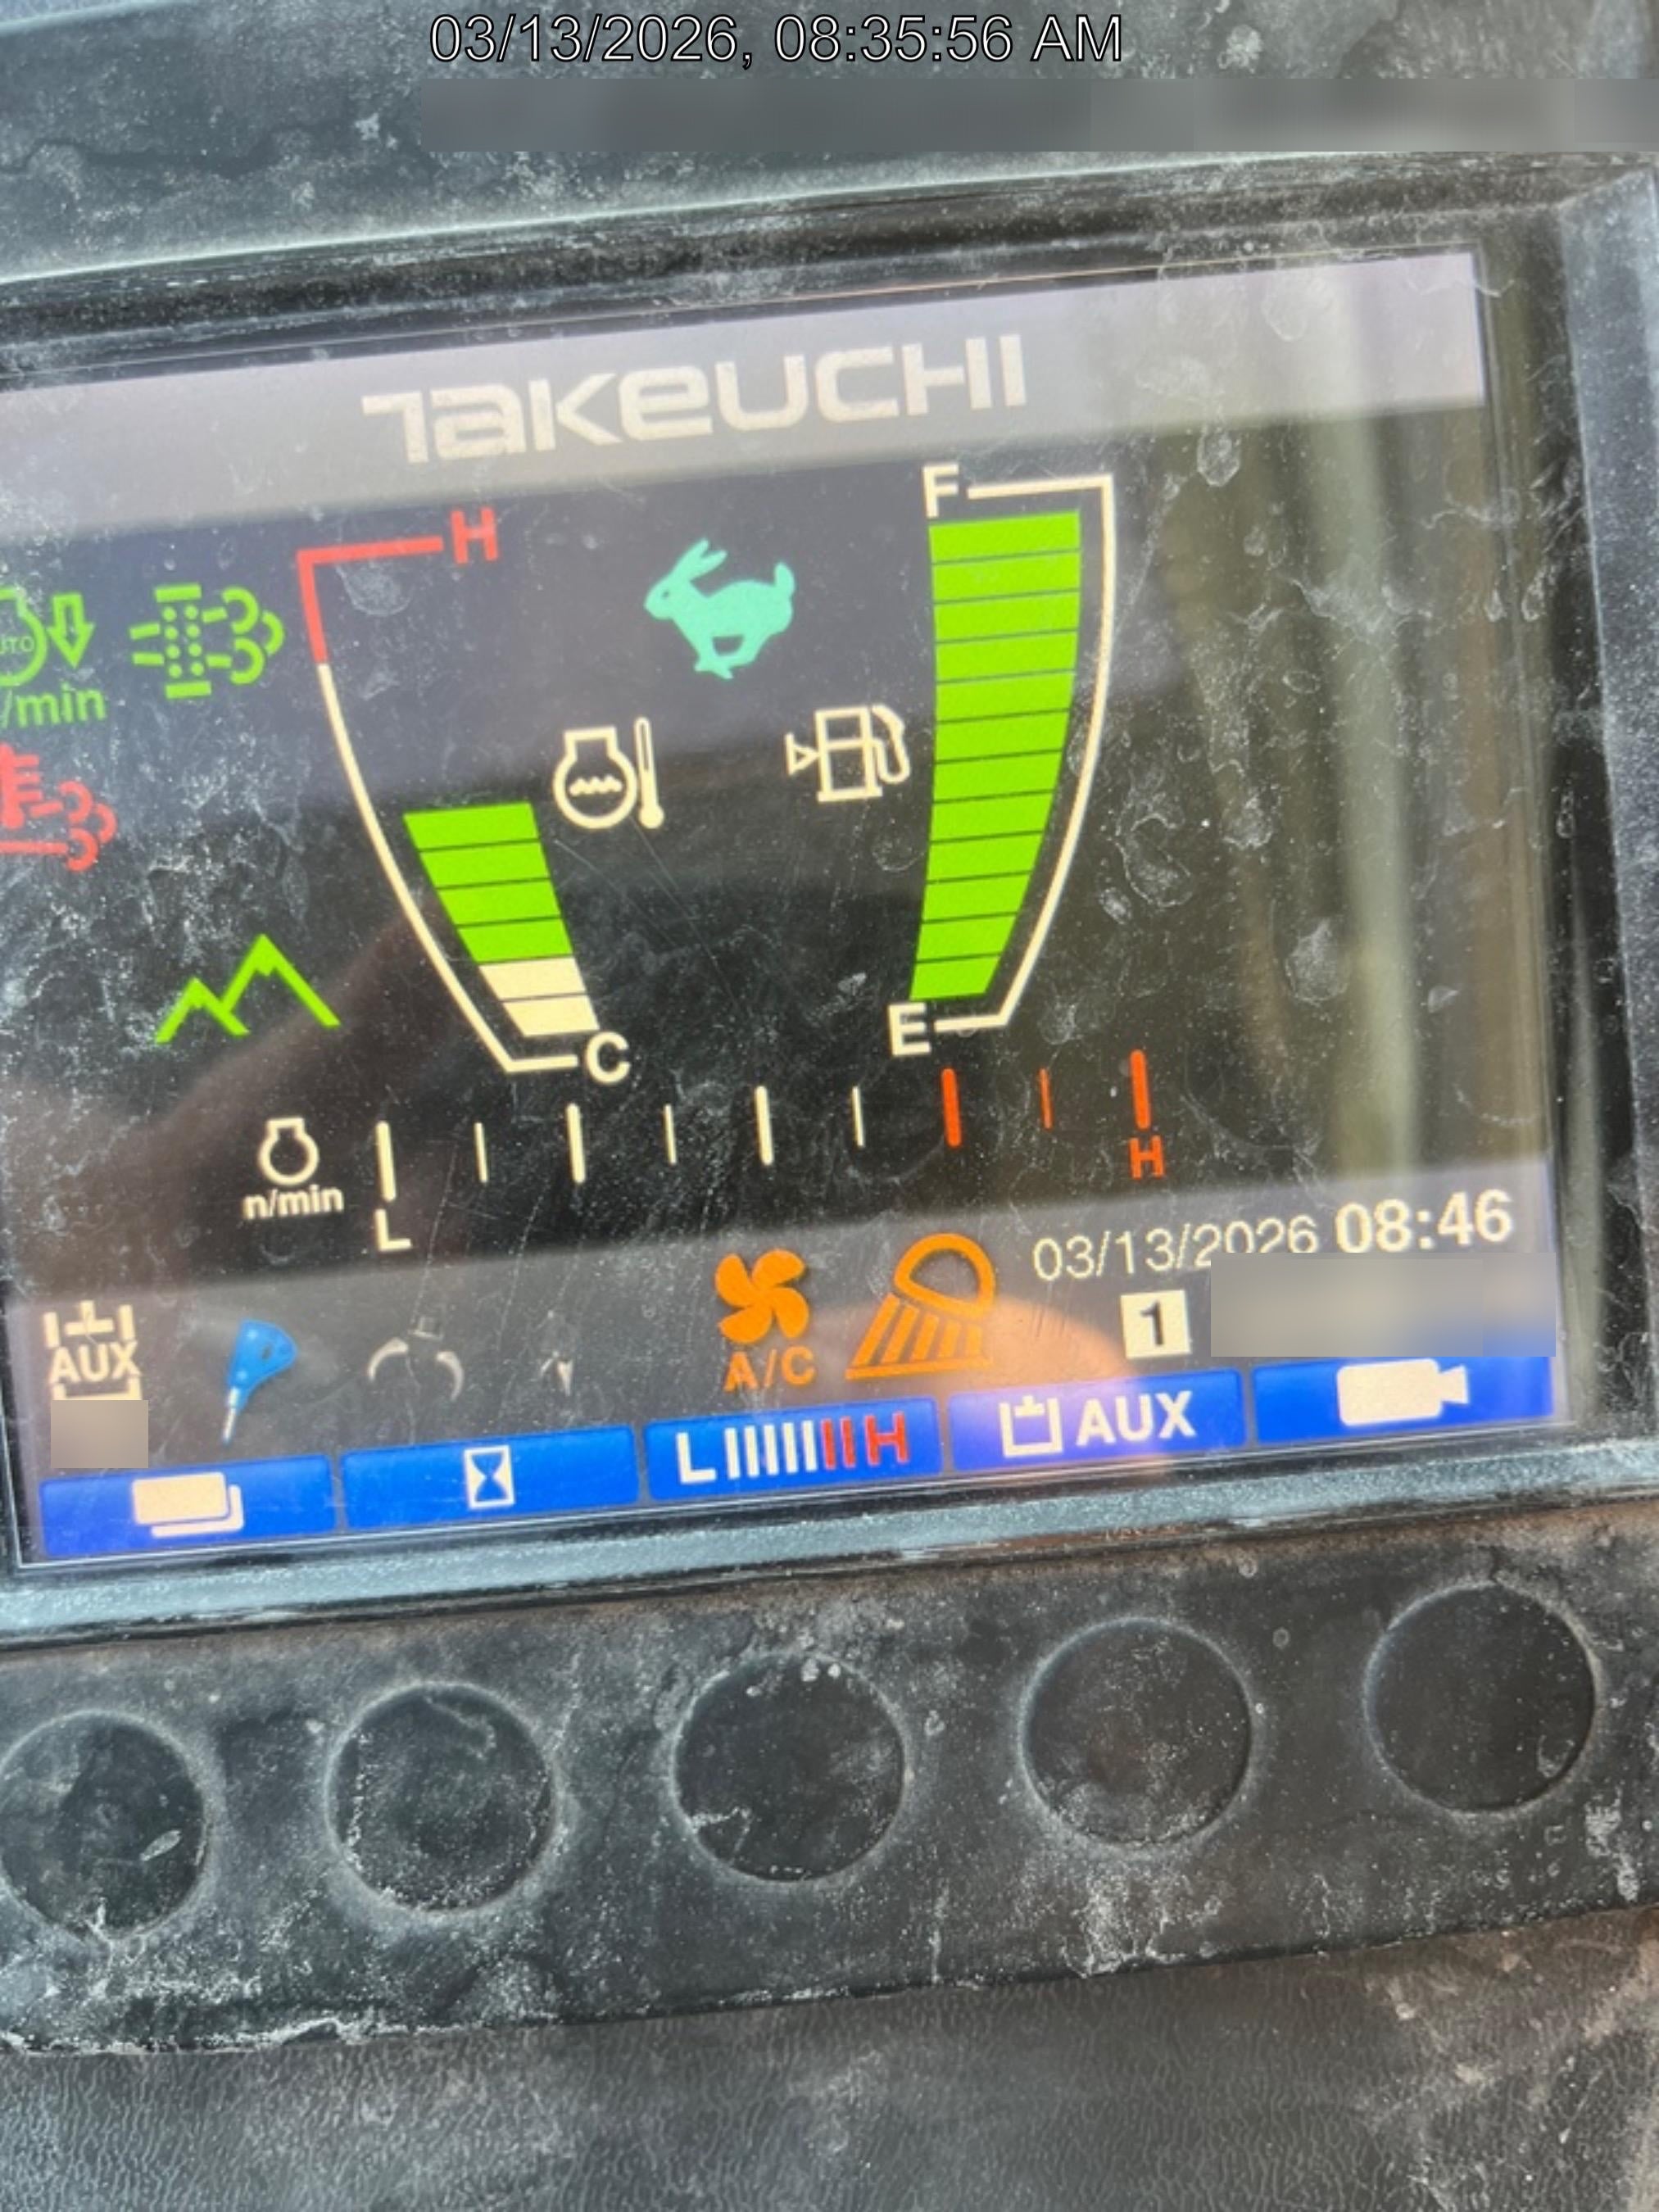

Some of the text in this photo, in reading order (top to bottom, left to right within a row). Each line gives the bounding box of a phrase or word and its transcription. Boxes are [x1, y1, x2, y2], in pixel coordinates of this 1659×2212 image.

[922, 463, 959, 519] F
[450, 507, 499, 565] H
[888, 1003, 931, 1058] E
[586, 1031, 632, 1084] C
[1128, 1135, 1165, 1180] H
[244, 1184, 344, 1219] n/min
[374, 1208, 411, 1252] L
[1031, 1189, 1514, 1282] 03/13/2026 08:46
[48, 1341, 143, 1385] AUX
[723, 1345, 816, 1392] A/C
[1075, 1390, 1197, 1447] AUX
